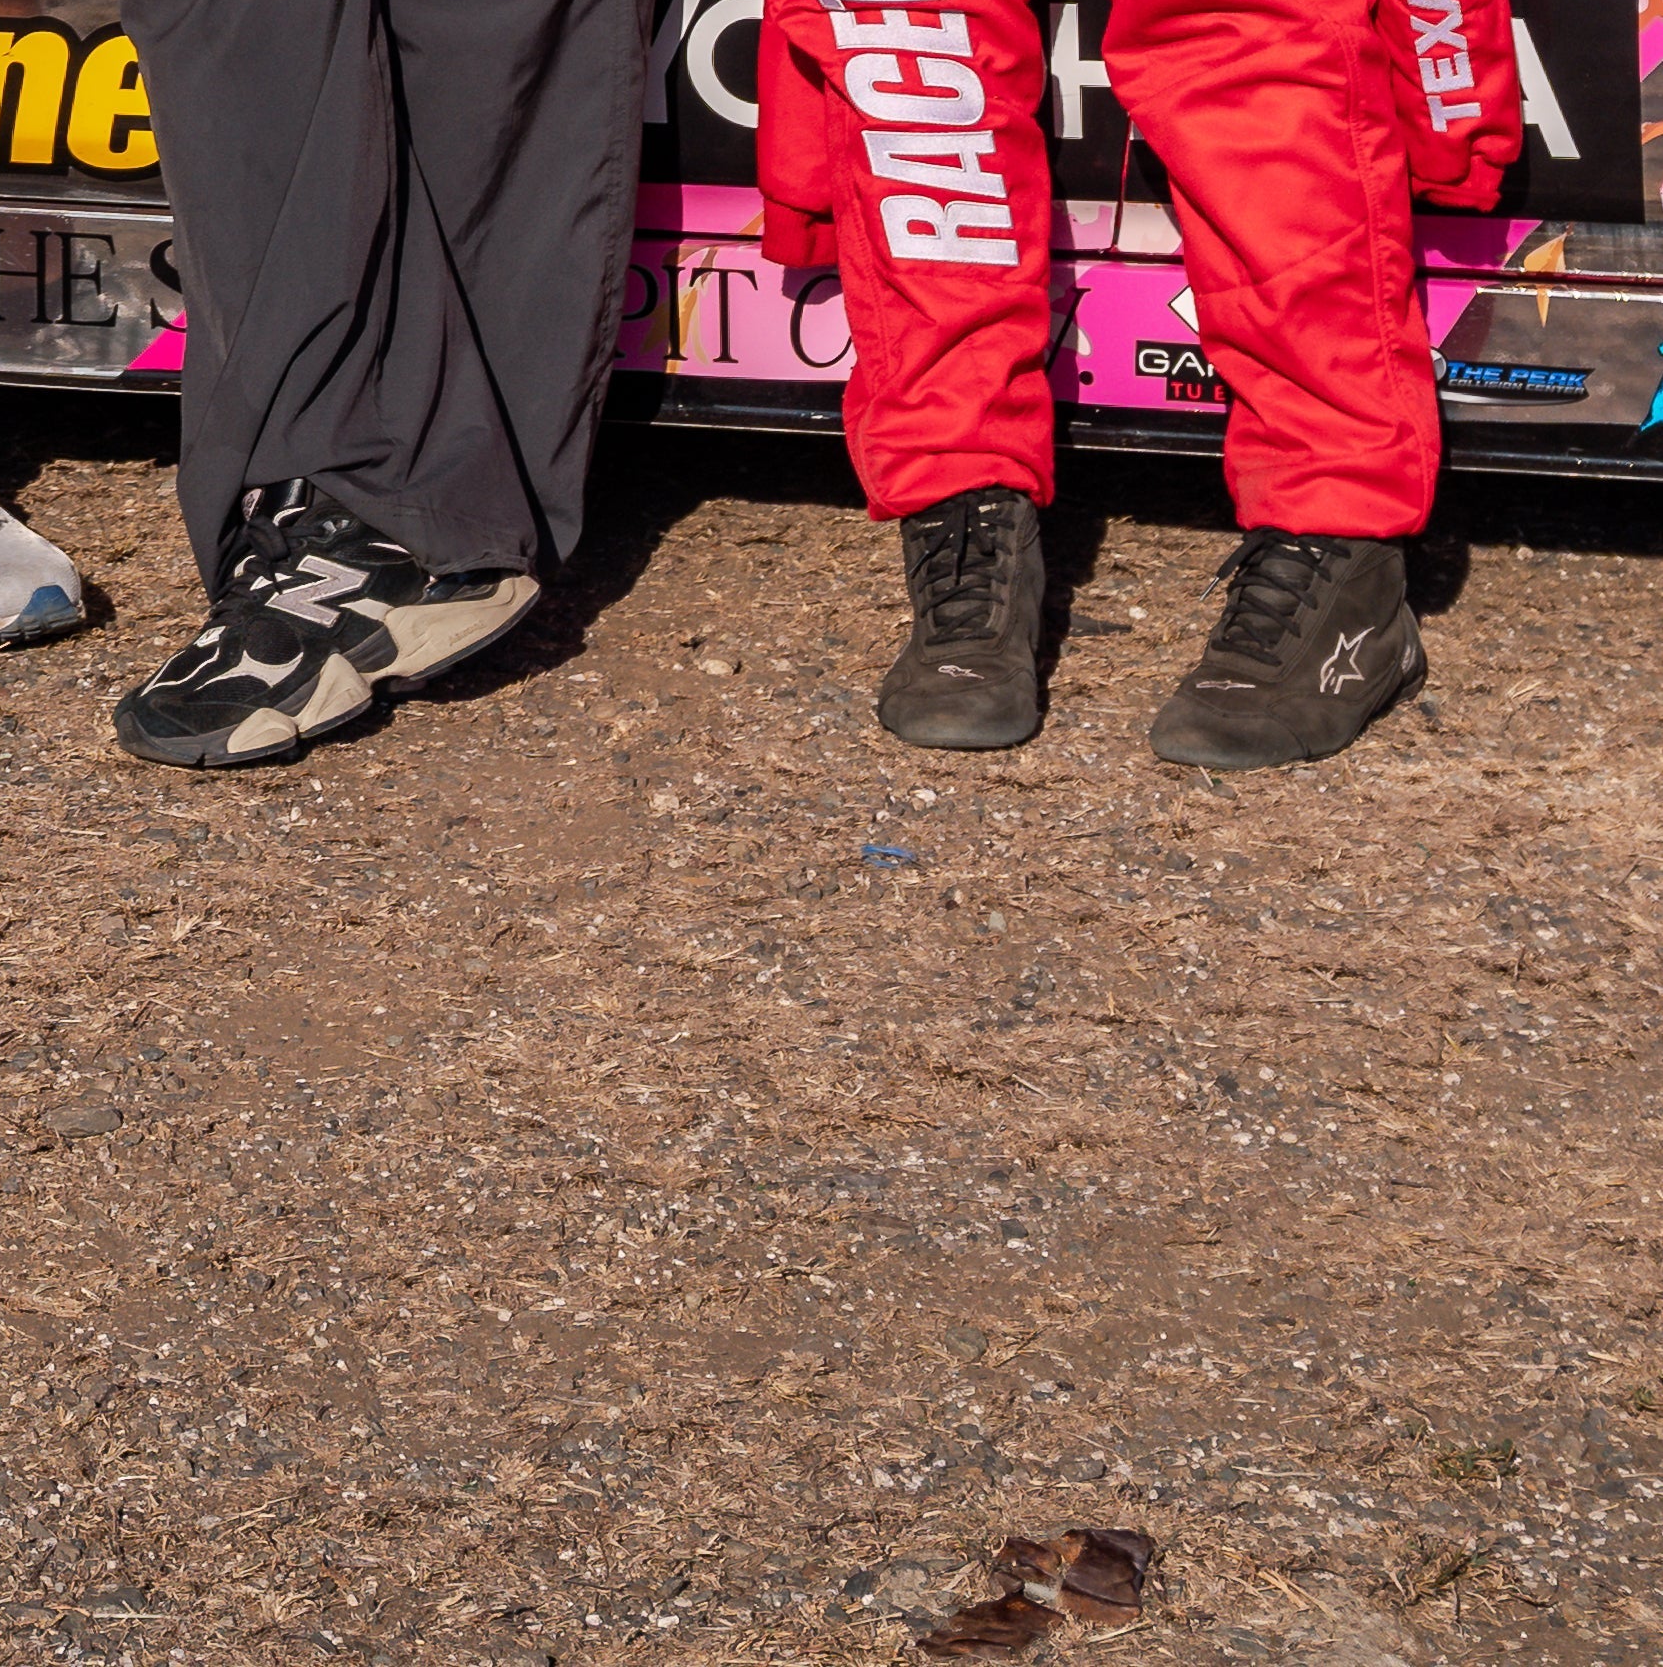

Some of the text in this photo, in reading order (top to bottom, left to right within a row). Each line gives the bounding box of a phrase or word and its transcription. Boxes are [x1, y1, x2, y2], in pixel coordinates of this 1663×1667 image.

[1447, 360, 1587, 388] THE PEAK
[1170, 382, 1202, 401] TU
[1447, 378, 1586, 395] COLLISION CENTER
